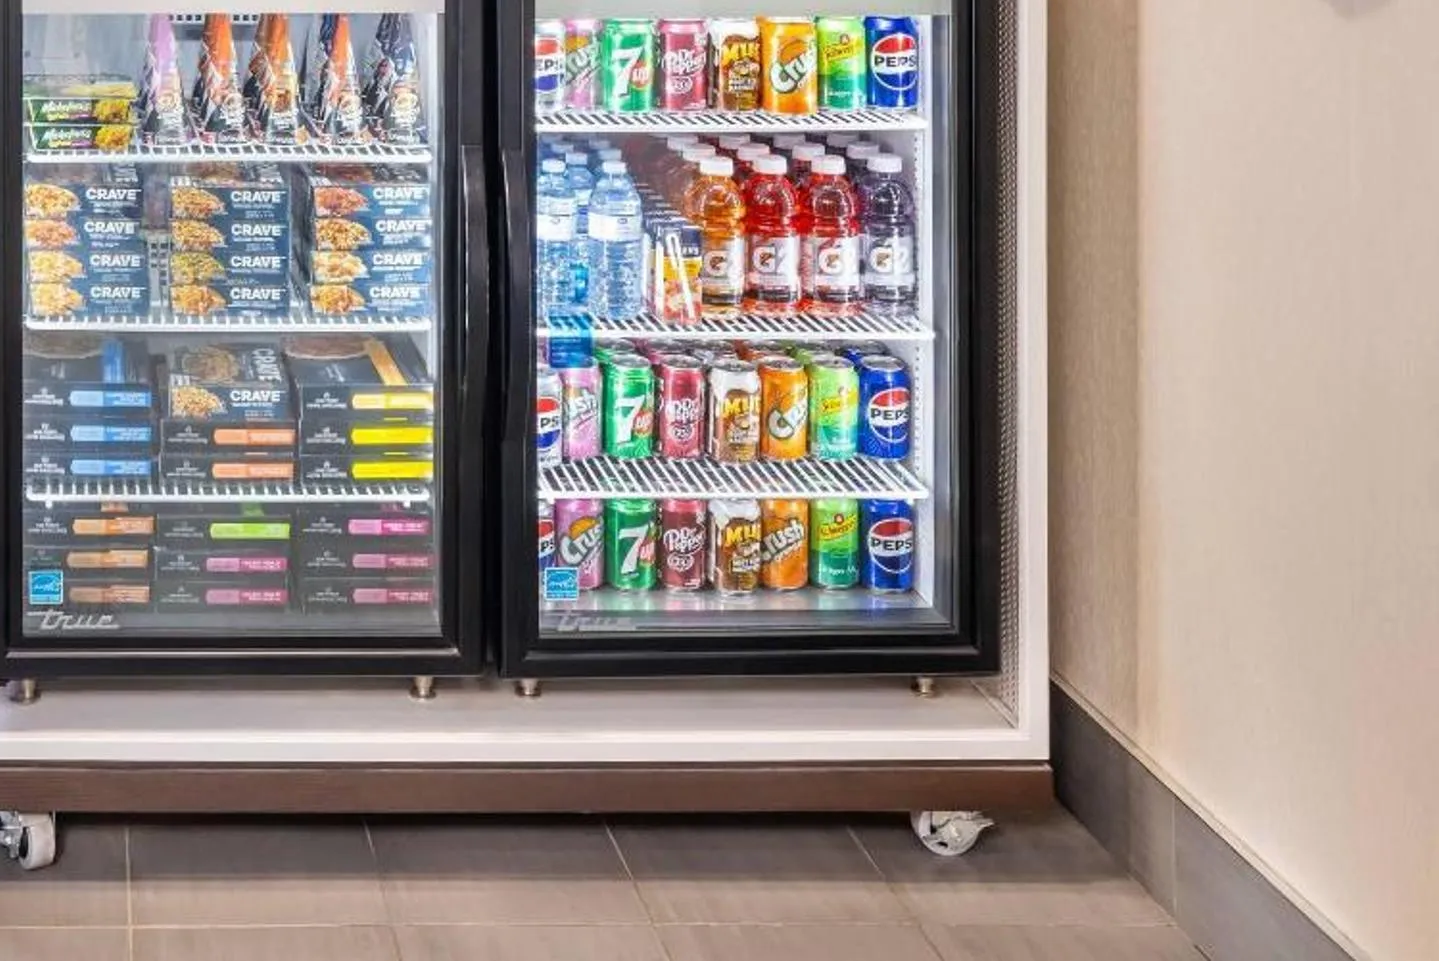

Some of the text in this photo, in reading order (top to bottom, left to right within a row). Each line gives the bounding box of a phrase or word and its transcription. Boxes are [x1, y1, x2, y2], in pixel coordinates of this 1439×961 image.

[874, 55, 917, 68] PEPS
[85, 188, 137, 200] CRAVE
[229, 190, 281, 203] CRAVE
[372, 186, 423, 199] CRAVE
[83, 221, 135, 234] CRAVE
[231, 223, 282, 236] CRAVE
[375, 219, 426, 232] CRAVE
[89, 254, 140, 267] CRAVE
[231, 256, 282, 269] CRAVE
[372, 253, 423, 265] CRAVE
[90, 286, 141, 299] CRAVE
[230, 287, 281, 300] CRAVE
[369, 286, 420, 298] CRAVE
[229, 390, 281, 401] CRAVE
[870, 408, 910, 421] PEPS
[871, 538, 913, 551] PEPS
